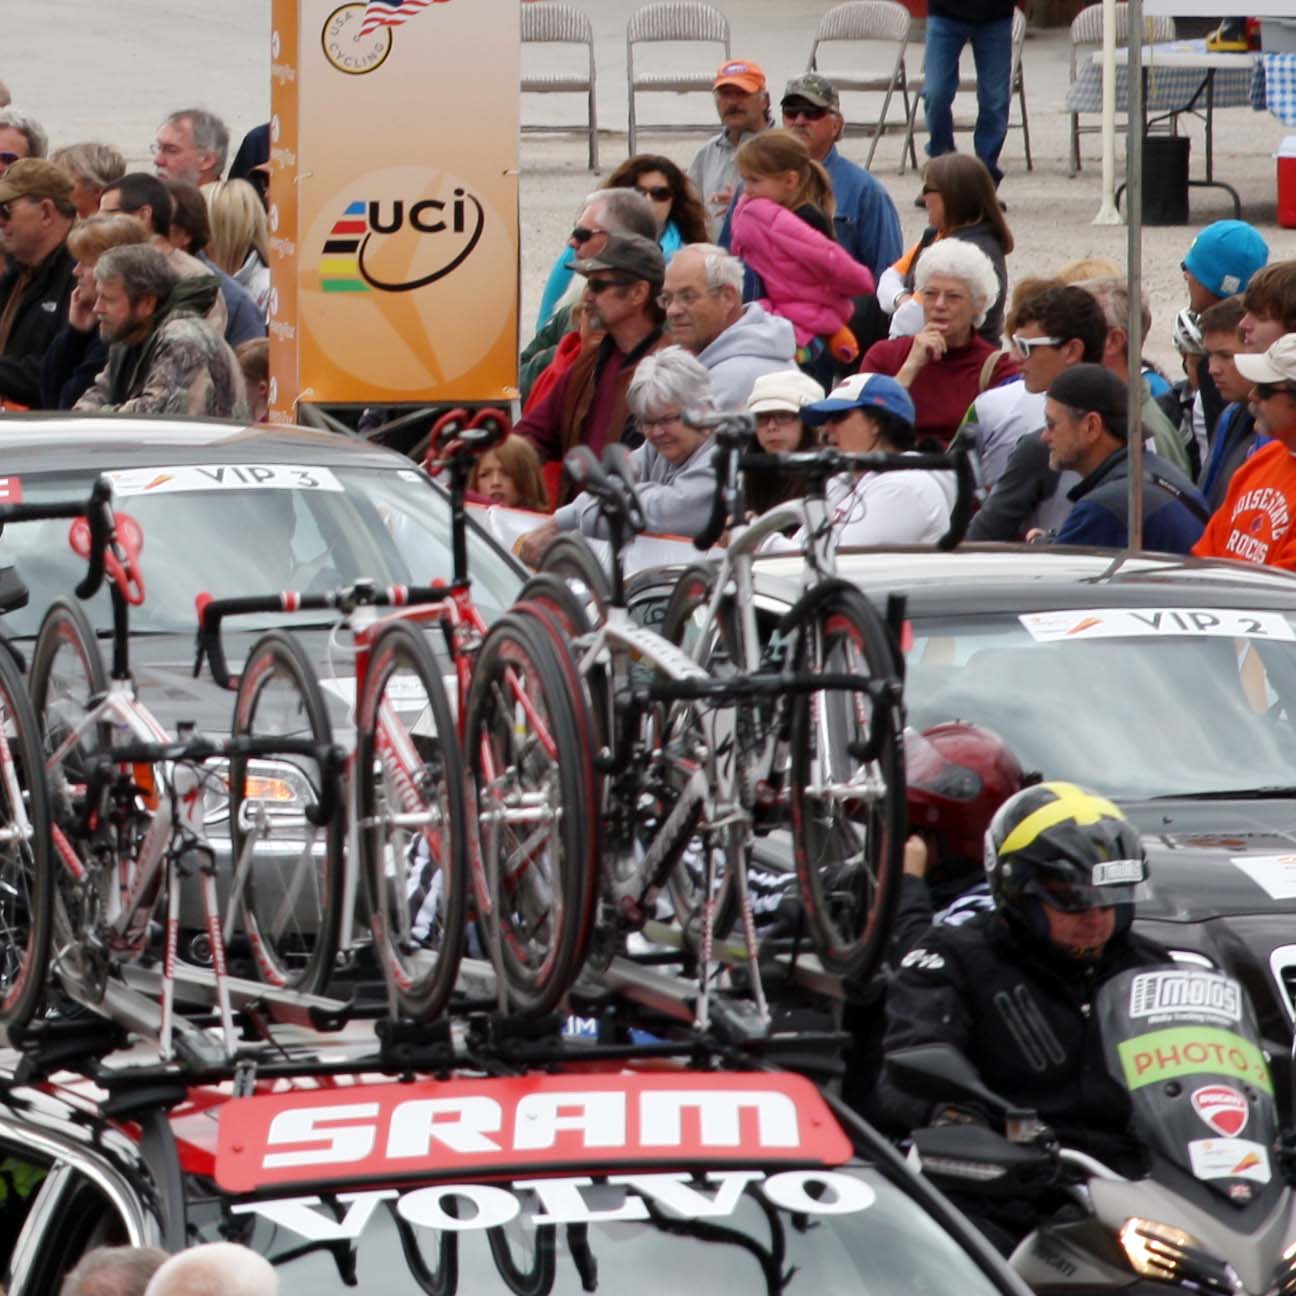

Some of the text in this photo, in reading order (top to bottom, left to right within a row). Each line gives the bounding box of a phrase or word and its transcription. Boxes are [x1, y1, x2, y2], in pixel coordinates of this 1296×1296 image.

[329, 11, 354, 36] USA
[328, 42, 385, 69] CYCLING
[194, 466, 322, 488] VIP 3
[1127, 611, 1268, 635] VIP 2
[1133, 1042, 1249, 1076] PHOTO
[1199, 1092, 1242, 1107] DUCATI
[263, 1089, 801, 1169] SRAM
[231, 1170, 877, 1241] VOLVO
